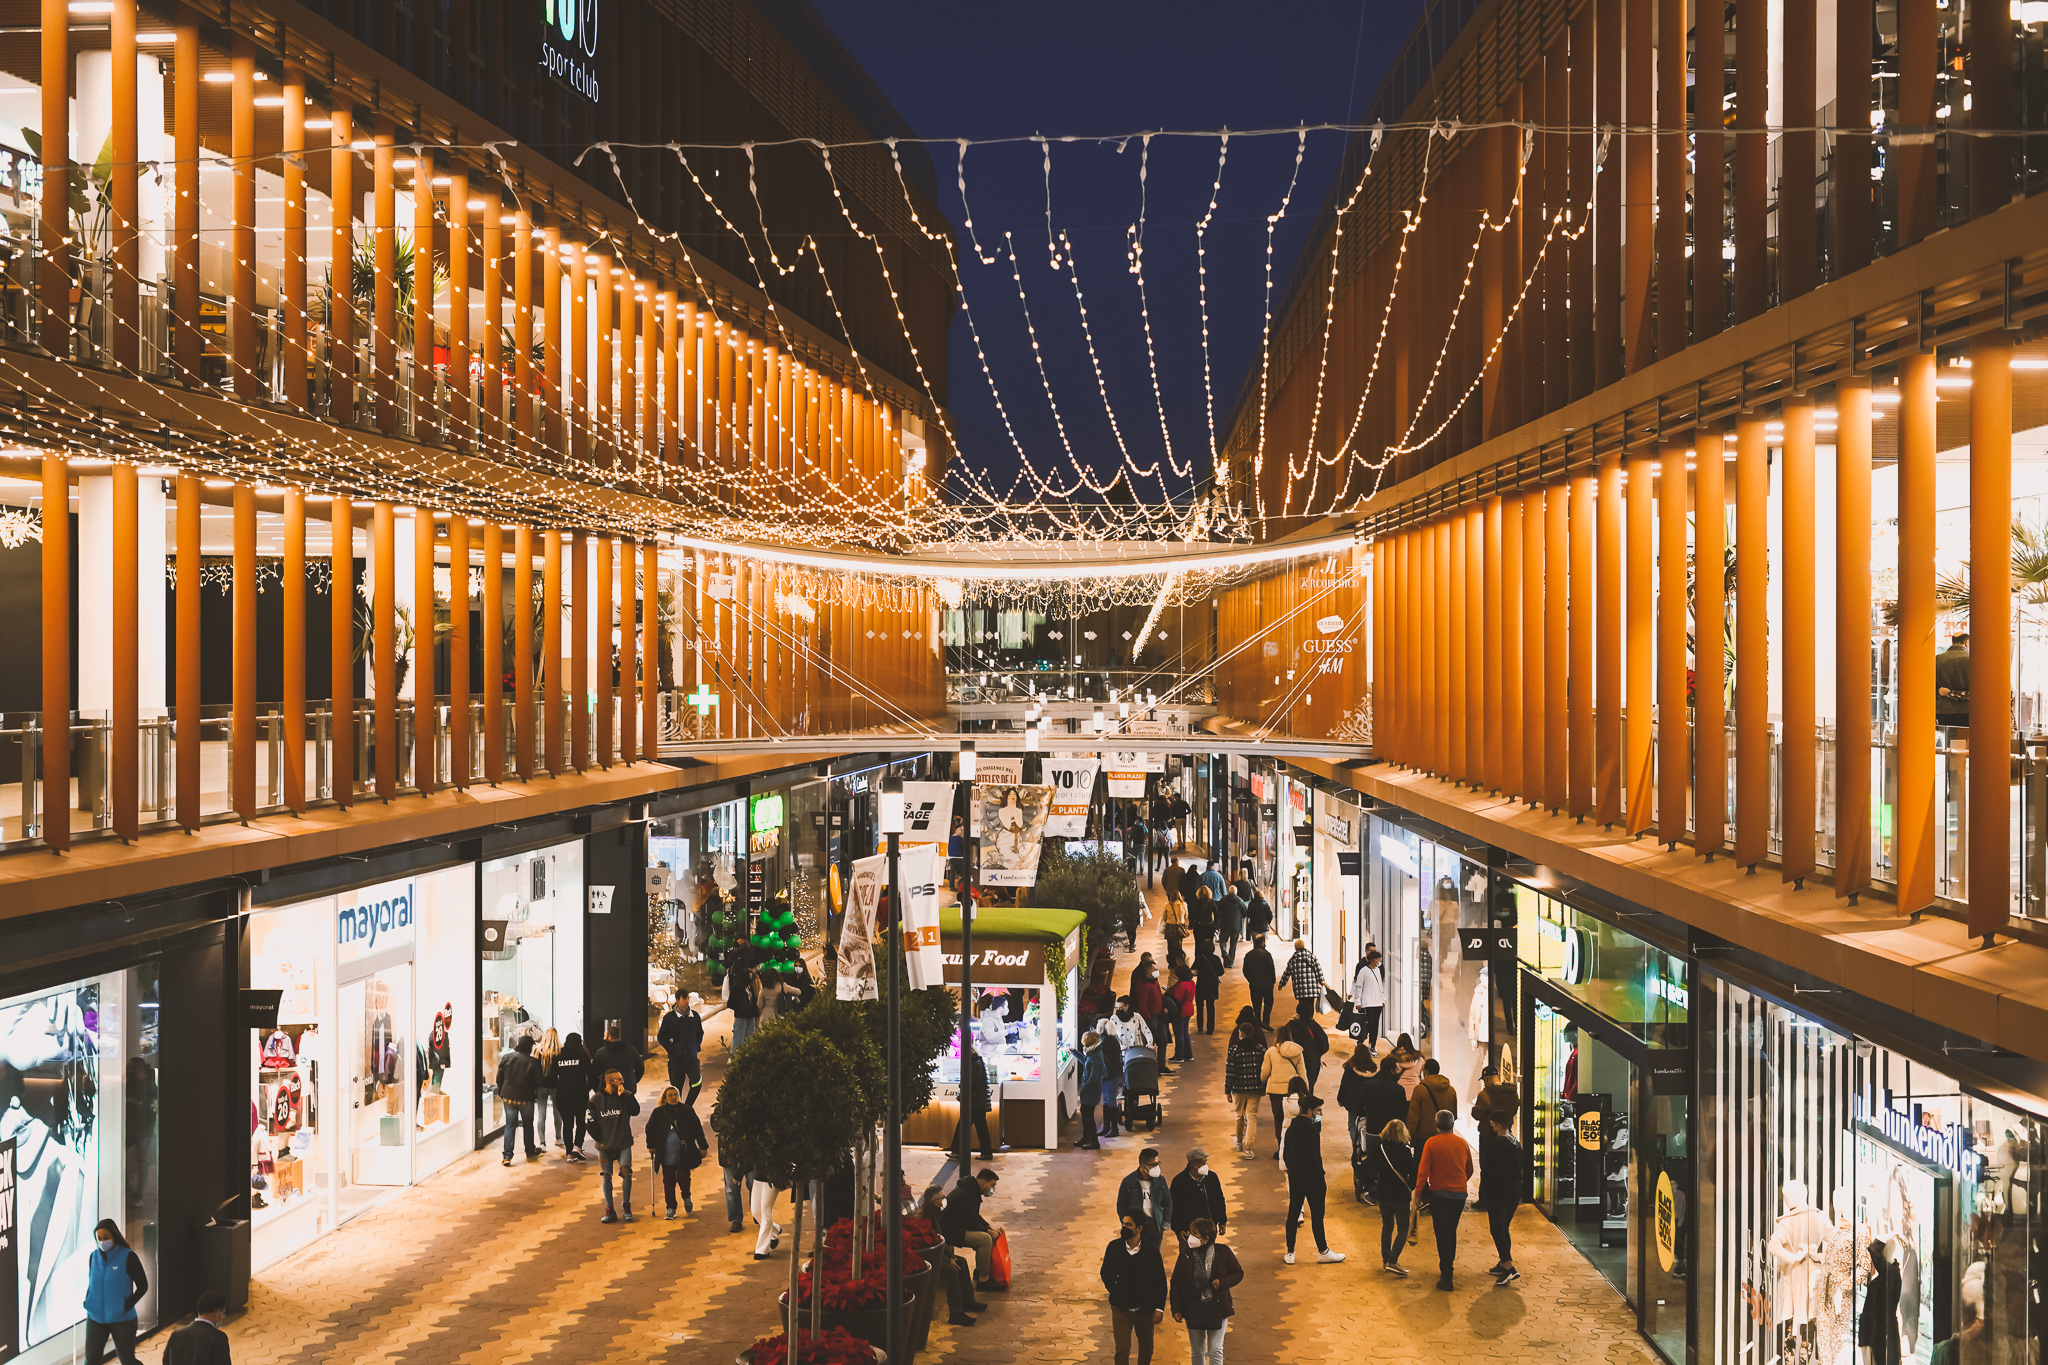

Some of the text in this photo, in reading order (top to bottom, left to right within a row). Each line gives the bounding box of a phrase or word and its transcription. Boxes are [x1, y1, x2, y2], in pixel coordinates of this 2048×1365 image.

[542, 42, 599, 103] sportclub
[1052, 770, 1092, 789] YO10
[1055, 791, 1091, 799] portclub
[338, 884, 413, 948] mayoral
[1468, 938, 1483, 949] JD
[981, 949, 1030, 966] Food
[278, 1101, 288, 1122] 20
[1880, 1088, 1982, 1185] hunkemöller
